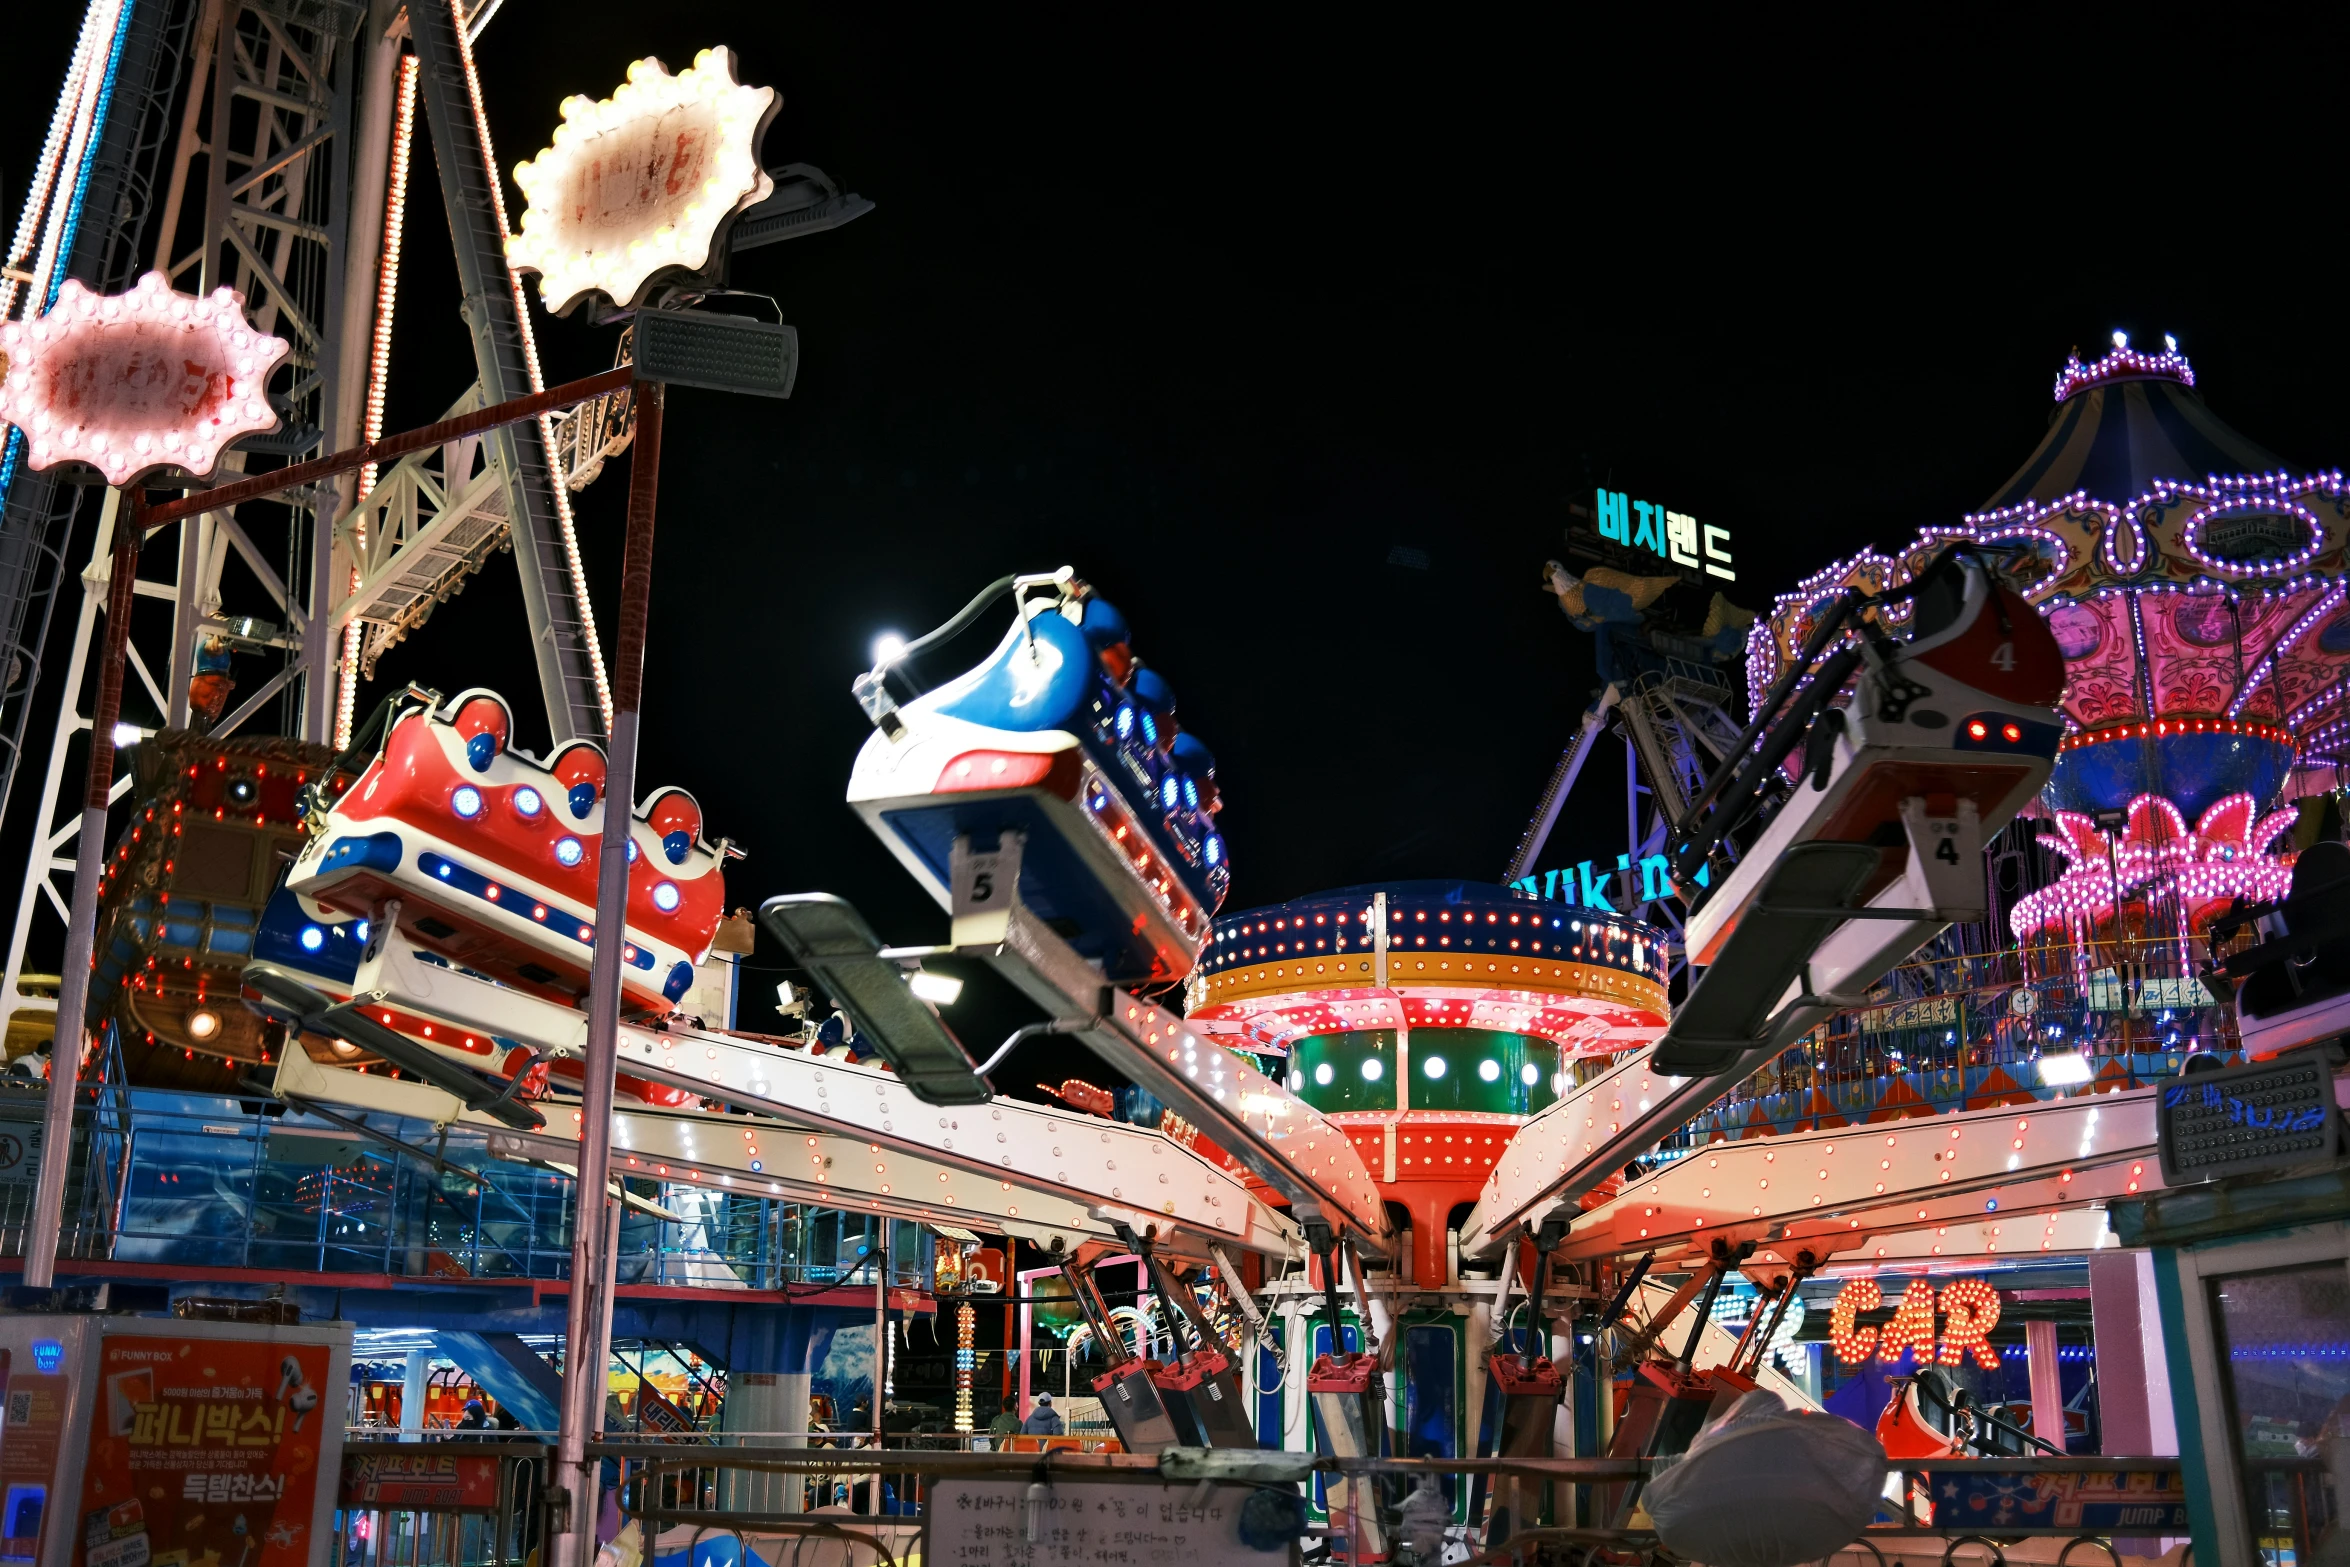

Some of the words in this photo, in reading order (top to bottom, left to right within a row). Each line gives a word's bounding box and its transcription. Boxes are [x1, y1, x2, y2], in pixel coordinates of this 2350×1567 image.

[1595, 487, 1737, 582] 비치랜드
[1990, 643, 2018, 672] 4
[363, 770, 384, 802] 6
[1936, 837, 1958, 866] 4
[970, 872, 994, 902] 5
[365, 939, 377, 963] 6
[1829, 1278, 2002, 1371] CAR
[34, 1345, 63, 1357] FUNNY
[37, 1356, 55, 1369] box
[121, 1350, 152, 1361] FUNNY
[153, 1351, 173, 1362] BOX
[162, 1387, 188, 1398] 5000원
[189, 1387, 210, 1398] 이상의
[211, 1386, 244, 1399] 즐거움이
[245, 1387, 263, 1400] 가득
[128, 1402, 286, 1446] 퍼니박스!
[129, 1450, 168, 1459] 퍼니박스에는
[182, 1473, 285, 1503] 득템찬스!
[356, 1453, 459, 1503] 점프보트
[399, 1487, 429, 1504] JUMP
[433, 1488, 466, 1504] BOAT
[1159, 1502, 1222, 1523] 없습니다
[2116, 1507, 2165, 1527] JUMP
